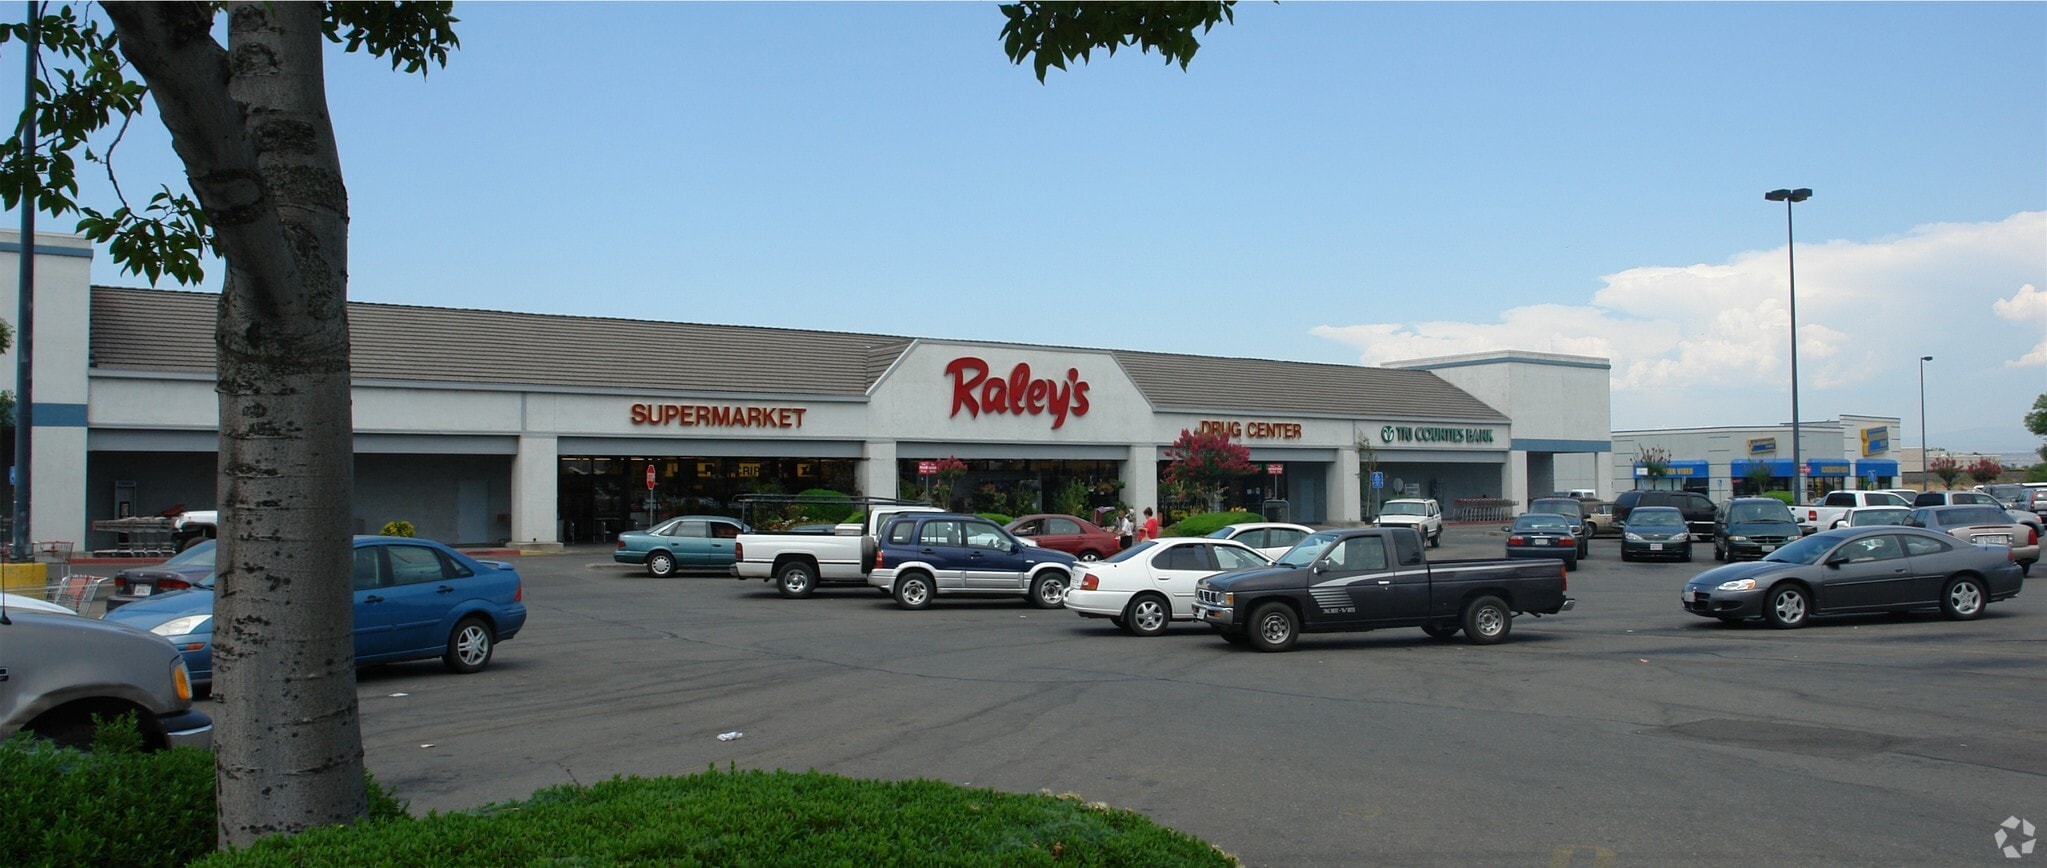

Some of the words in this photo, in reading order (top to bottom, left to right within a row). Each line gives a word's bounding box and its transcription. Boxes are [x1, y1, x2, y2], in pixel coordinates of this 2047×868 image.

[944, 357, 1090, 430] Raley's
[631, 404, 807, 428] SUPERMARKET
[1201, 421, 1241, 437] DRUG
[1247, 422, 1302, 439] CENTER
[1415, 427, 1465, 443] COUNTIES
[1466, 429, 1495, 443] BANK
